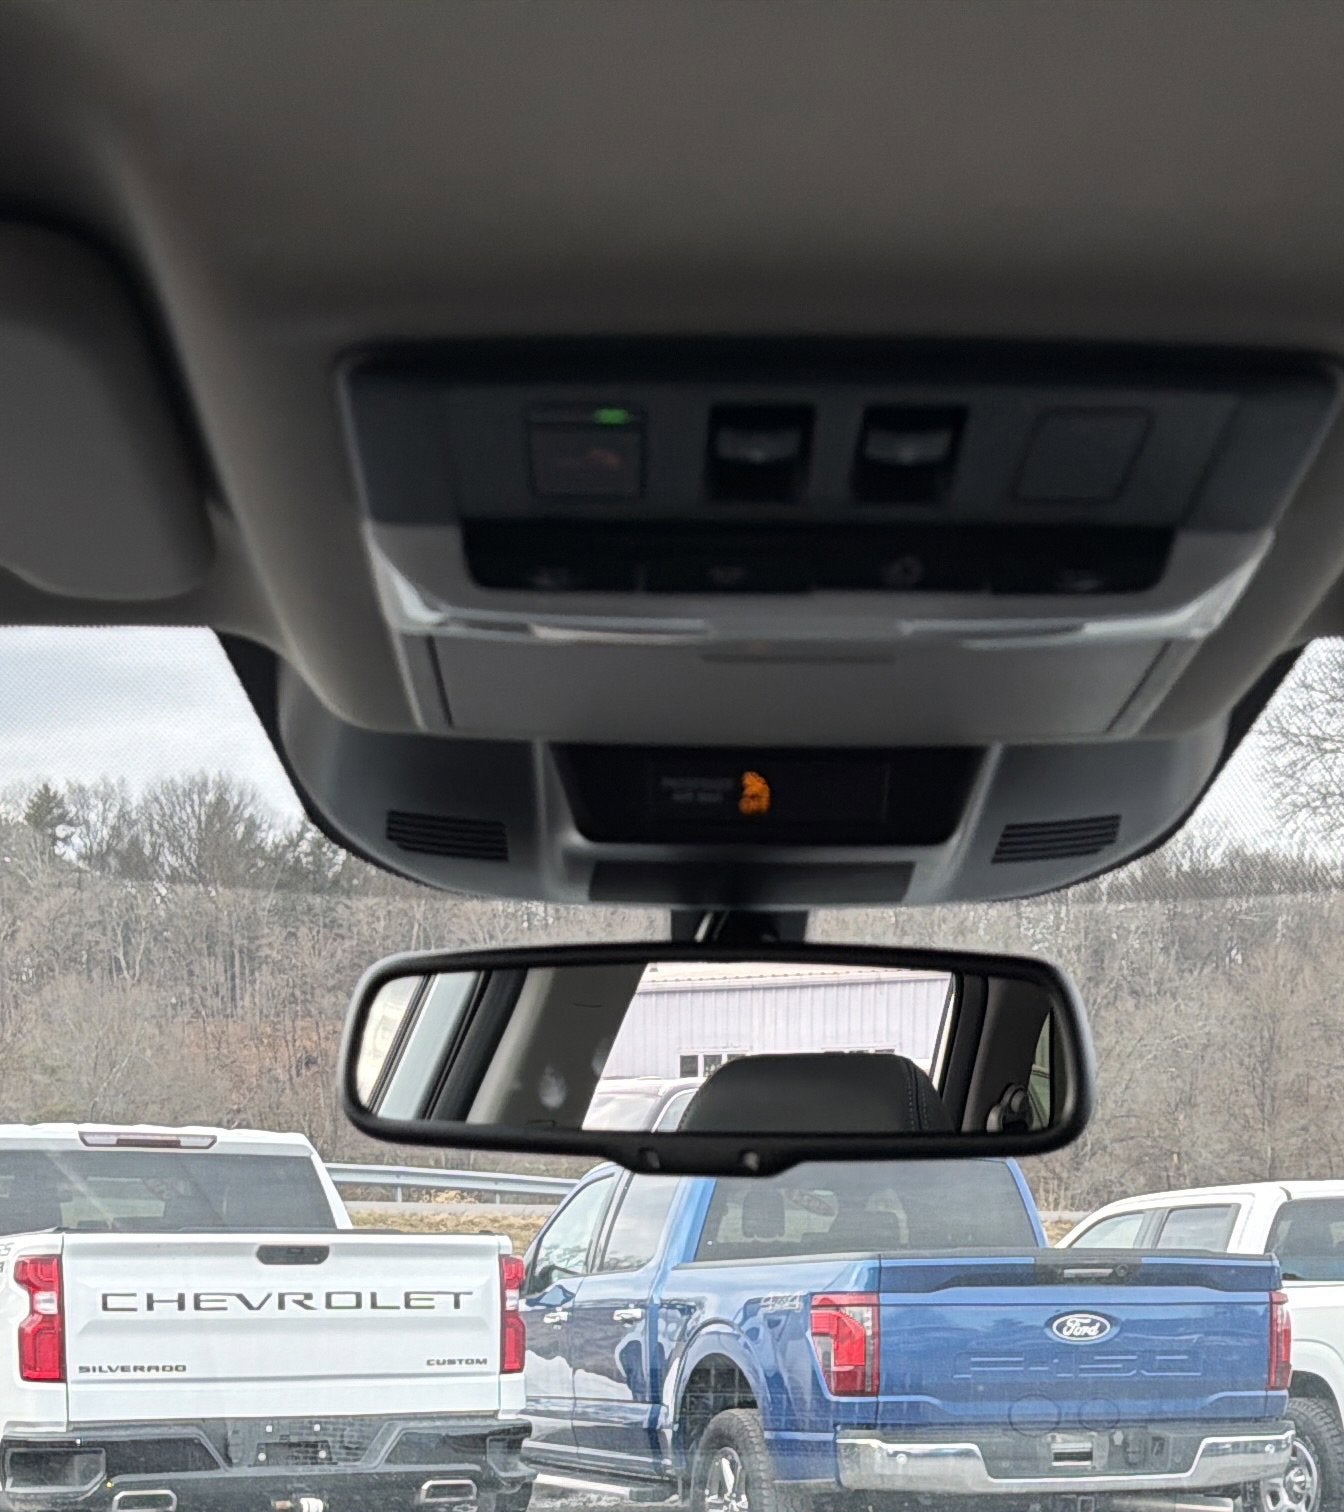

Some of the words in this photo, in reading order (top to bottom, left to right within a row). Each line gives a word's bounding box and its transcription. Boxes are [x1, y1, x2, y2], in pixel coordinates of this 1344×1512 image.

[101, 1291, 473, 1312] CHEVROLET
[1061, 1315, 1101, 1338] Ford
[77, 1364, 187, 1374] SILVERADO
[426, 1358, 488, 1367] CUSTOM
